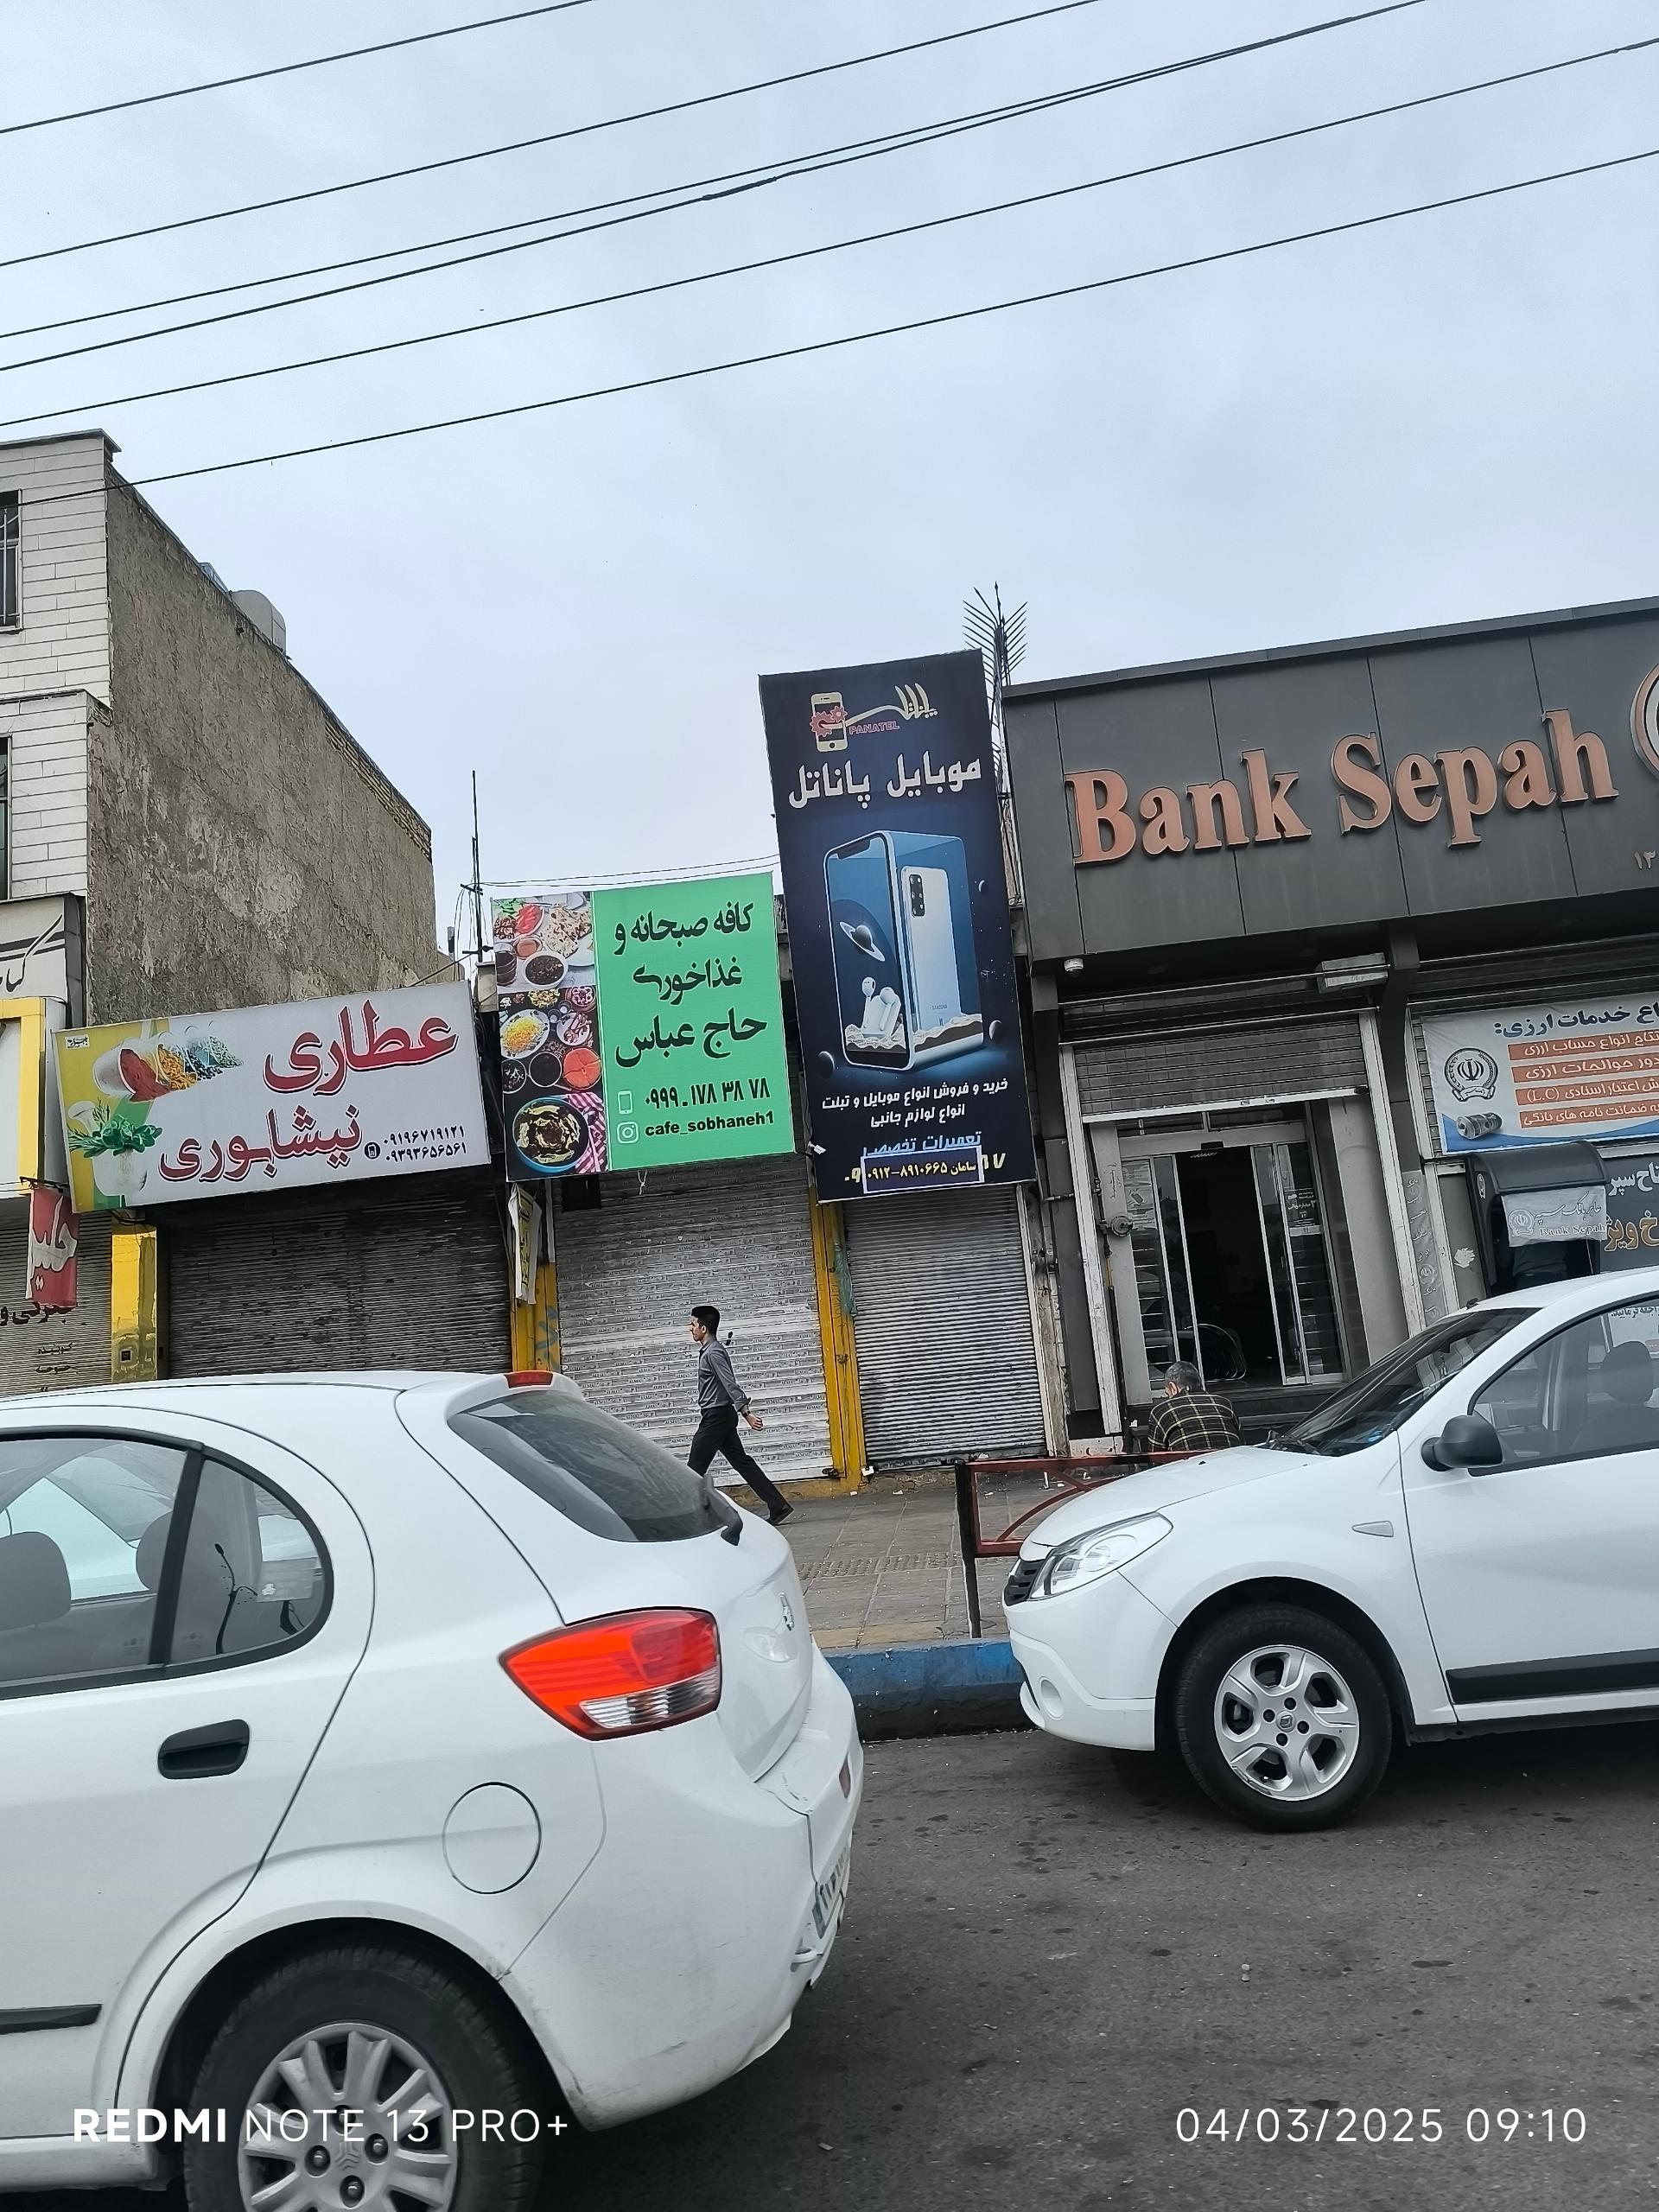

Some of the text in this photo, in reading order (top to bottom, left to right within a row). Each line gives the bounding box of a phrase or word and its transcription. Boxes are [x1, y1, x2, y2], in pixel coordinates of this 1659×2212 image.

[849, 721, 900, 734] PANATEL
[789, 751, 982, 809] موبایل پاناتل
[1064, 709, 1619, 865] Bank Sepah
[613, 901, 754, 956] کافه صبحانه و
[632, 956, 742, 1005] غذاخوری
[1557, 1005, 1631, 1028] خدمات
[615, 1007, 767, 1068] حاج عباس
[1552, 1039, 1596, 1054] حساب
[1599, 1033, 1630, 1050] انواع
[263, 999, 460, 1096] عطاری
[1523, 1041, 1549, 1057] ارزی
[1525, 1064, 1558, 1079] ارزی
[822, 1077, 1009, 1109] خرید و فروش انواع موبایل و تبلت
[1526, 1087, 1560, 1102] (L.C)
[1565, 1084, 1606, 1100] اسنادی
[1609, 1080, 1640, 1096] اعتبار
[870, 1103, 966, 1128] انواع لوازم جانبی
[1556, 1109, 1577, 1122] های
[1580, 1107, 1603, 1119] نامه
[1605, 1103, 1647, 1117] ضمانت
[645, 1110, 775, 1136] cafe_sobhaneh1
[1522, 1115, 1554, 1127] بانکی
[158, 1103, 364, 1182] نیشابوری
[383, 1125, 465, 1146] ۰۹۱۹۶۷۱۹۱۲۱
[385, 1141, 467, 1163] ۰۹۳۹۳۶۵۶۵۶۱
[1538, 1223, 1606, 1237] Bank Sepah
